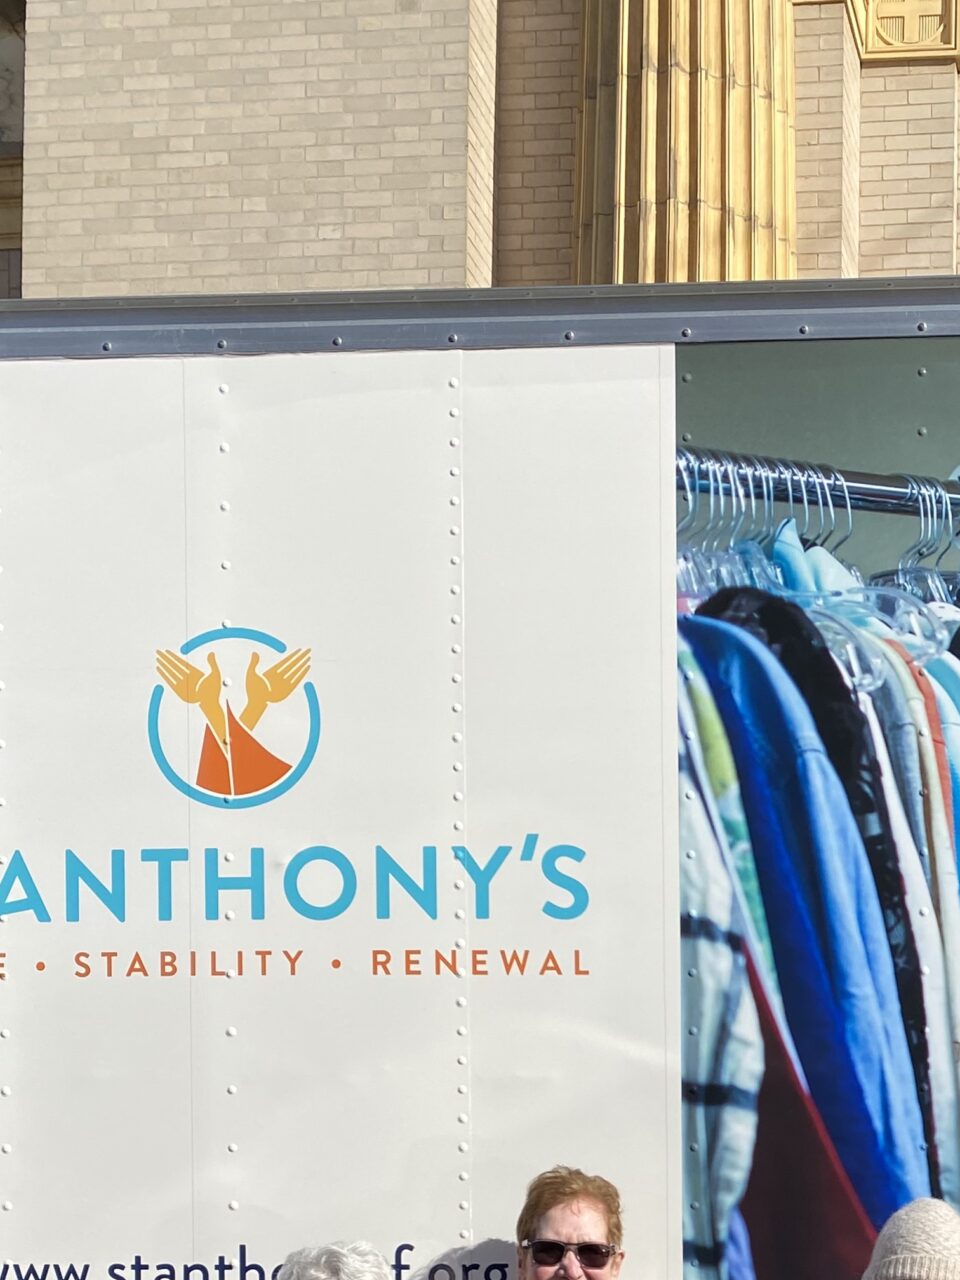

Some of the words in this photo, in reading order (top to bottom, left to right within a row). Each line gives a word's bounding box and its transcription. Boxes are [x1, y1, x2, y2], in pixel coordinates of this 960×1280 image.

[0, 834, 590, 923] ANTHONY'S
[73, 949, 305, 979] STABILITY
[372, 948, 590, 977] RENEWAL
